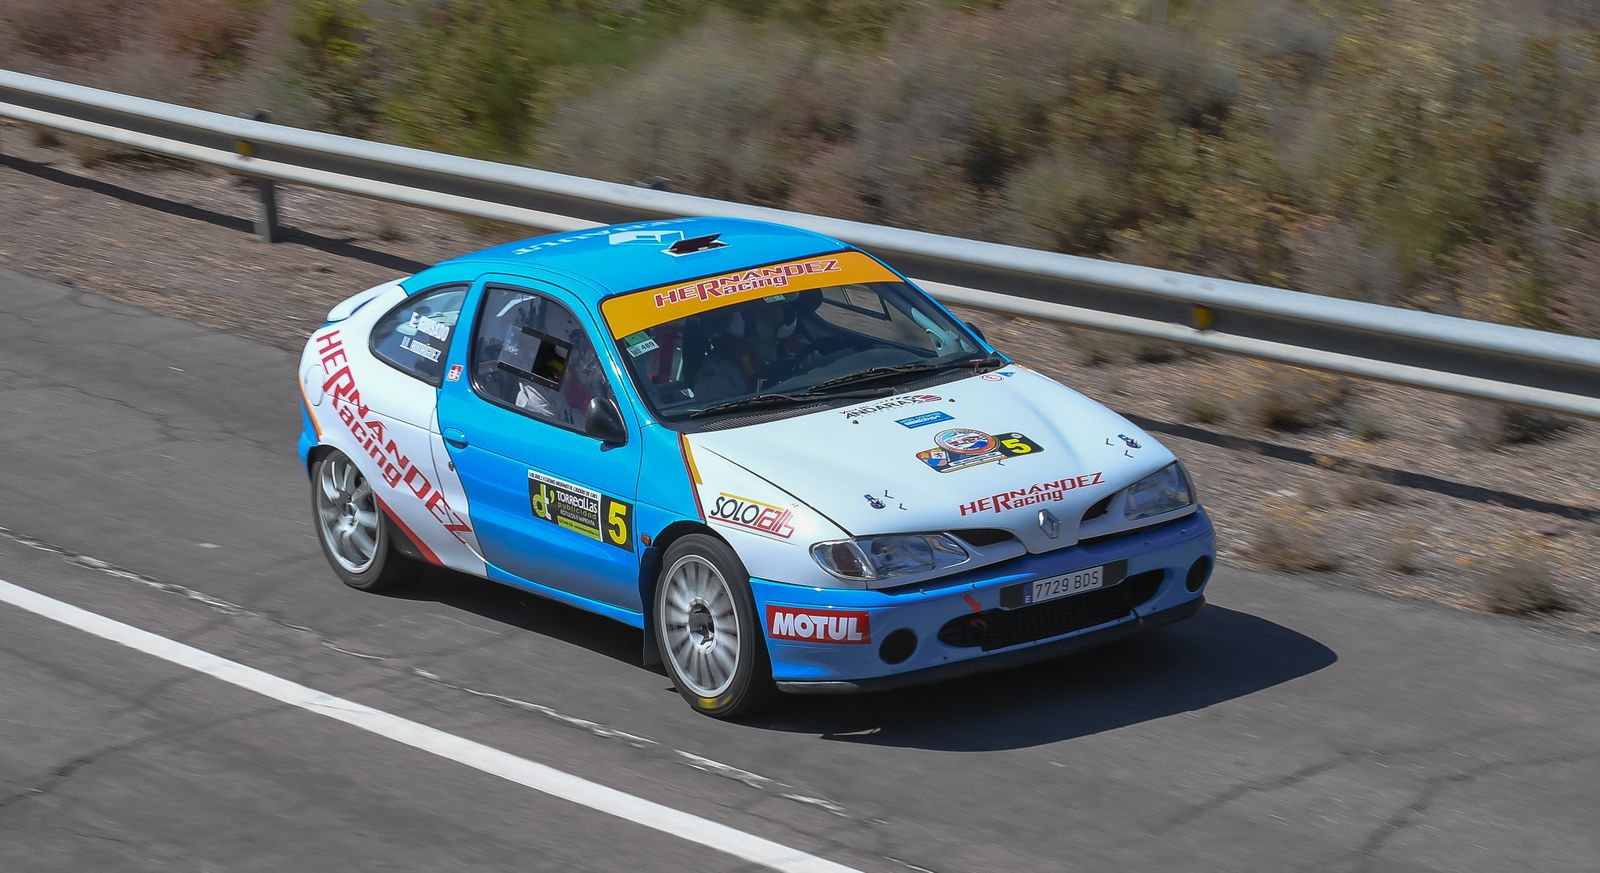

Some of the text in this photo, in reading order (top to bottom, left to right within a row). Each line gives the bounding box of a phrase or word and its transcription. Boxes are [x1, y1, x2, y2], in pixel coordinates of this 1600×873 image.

[1001, 438, 1032, 454] 5
[608, 501, 627, 545] 5
[1035, 580, 1069, 599] 7729
[1074, 570, 1099, 590] BDS
[772, 611, 863, 641] MOTUL
